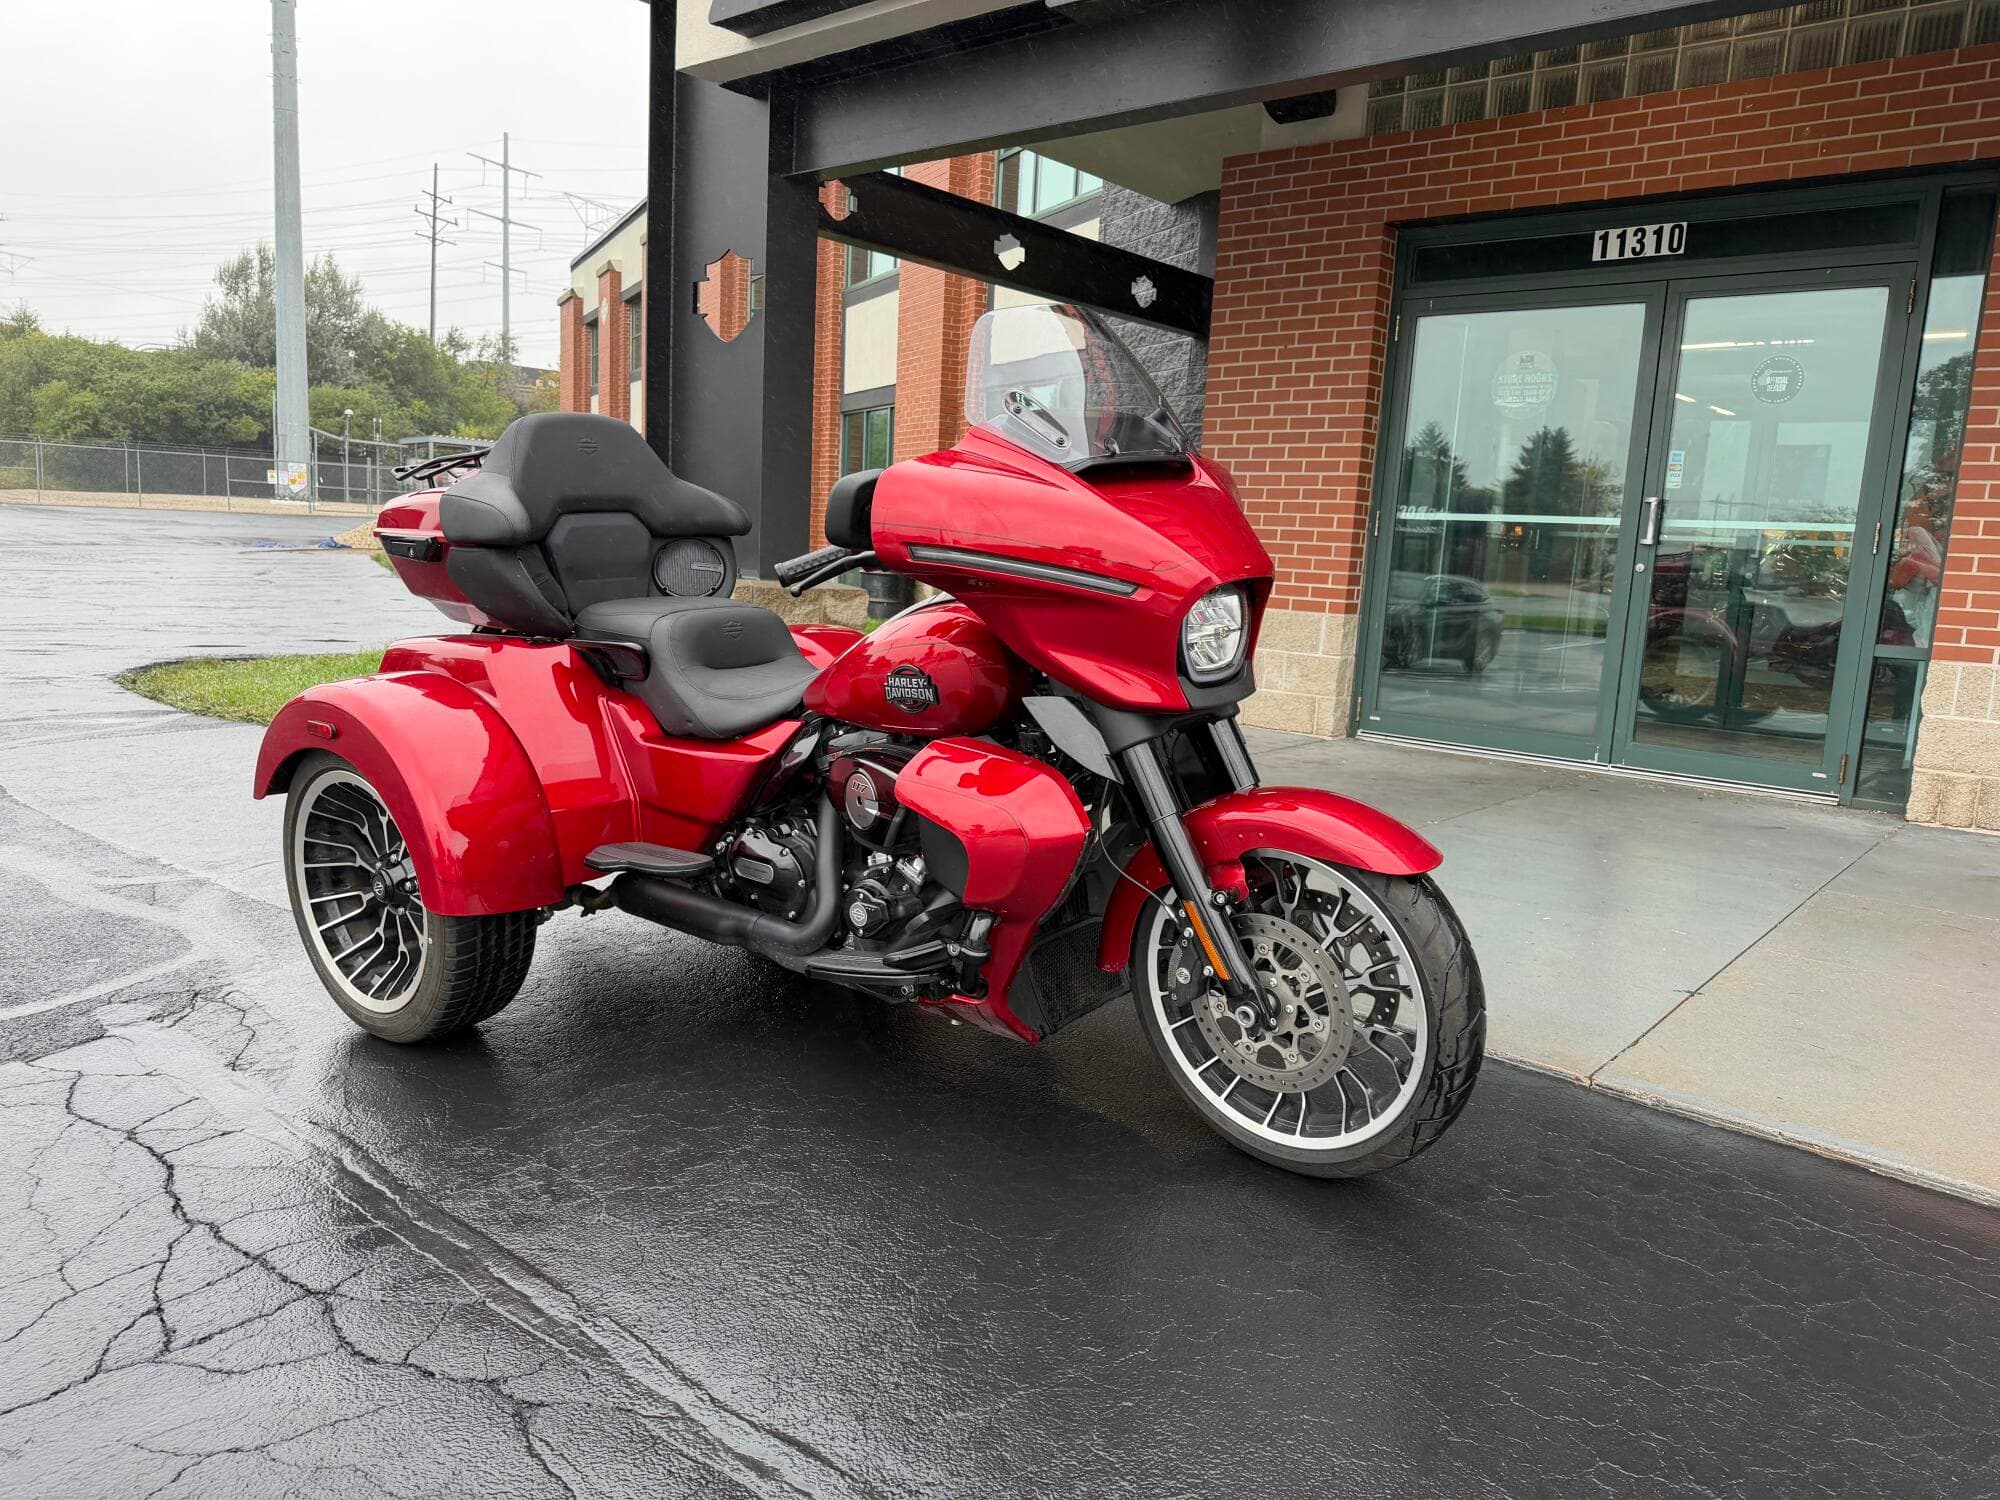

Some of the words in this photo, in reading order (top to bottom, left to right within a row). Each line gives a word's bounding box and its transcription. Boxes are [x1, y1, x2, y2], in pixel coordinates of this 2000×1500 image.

[1598, 223, 1685, 259] 11310
[885, 687, 934, 702] DAVIDSON
[851, 780, 869, 793] 117
